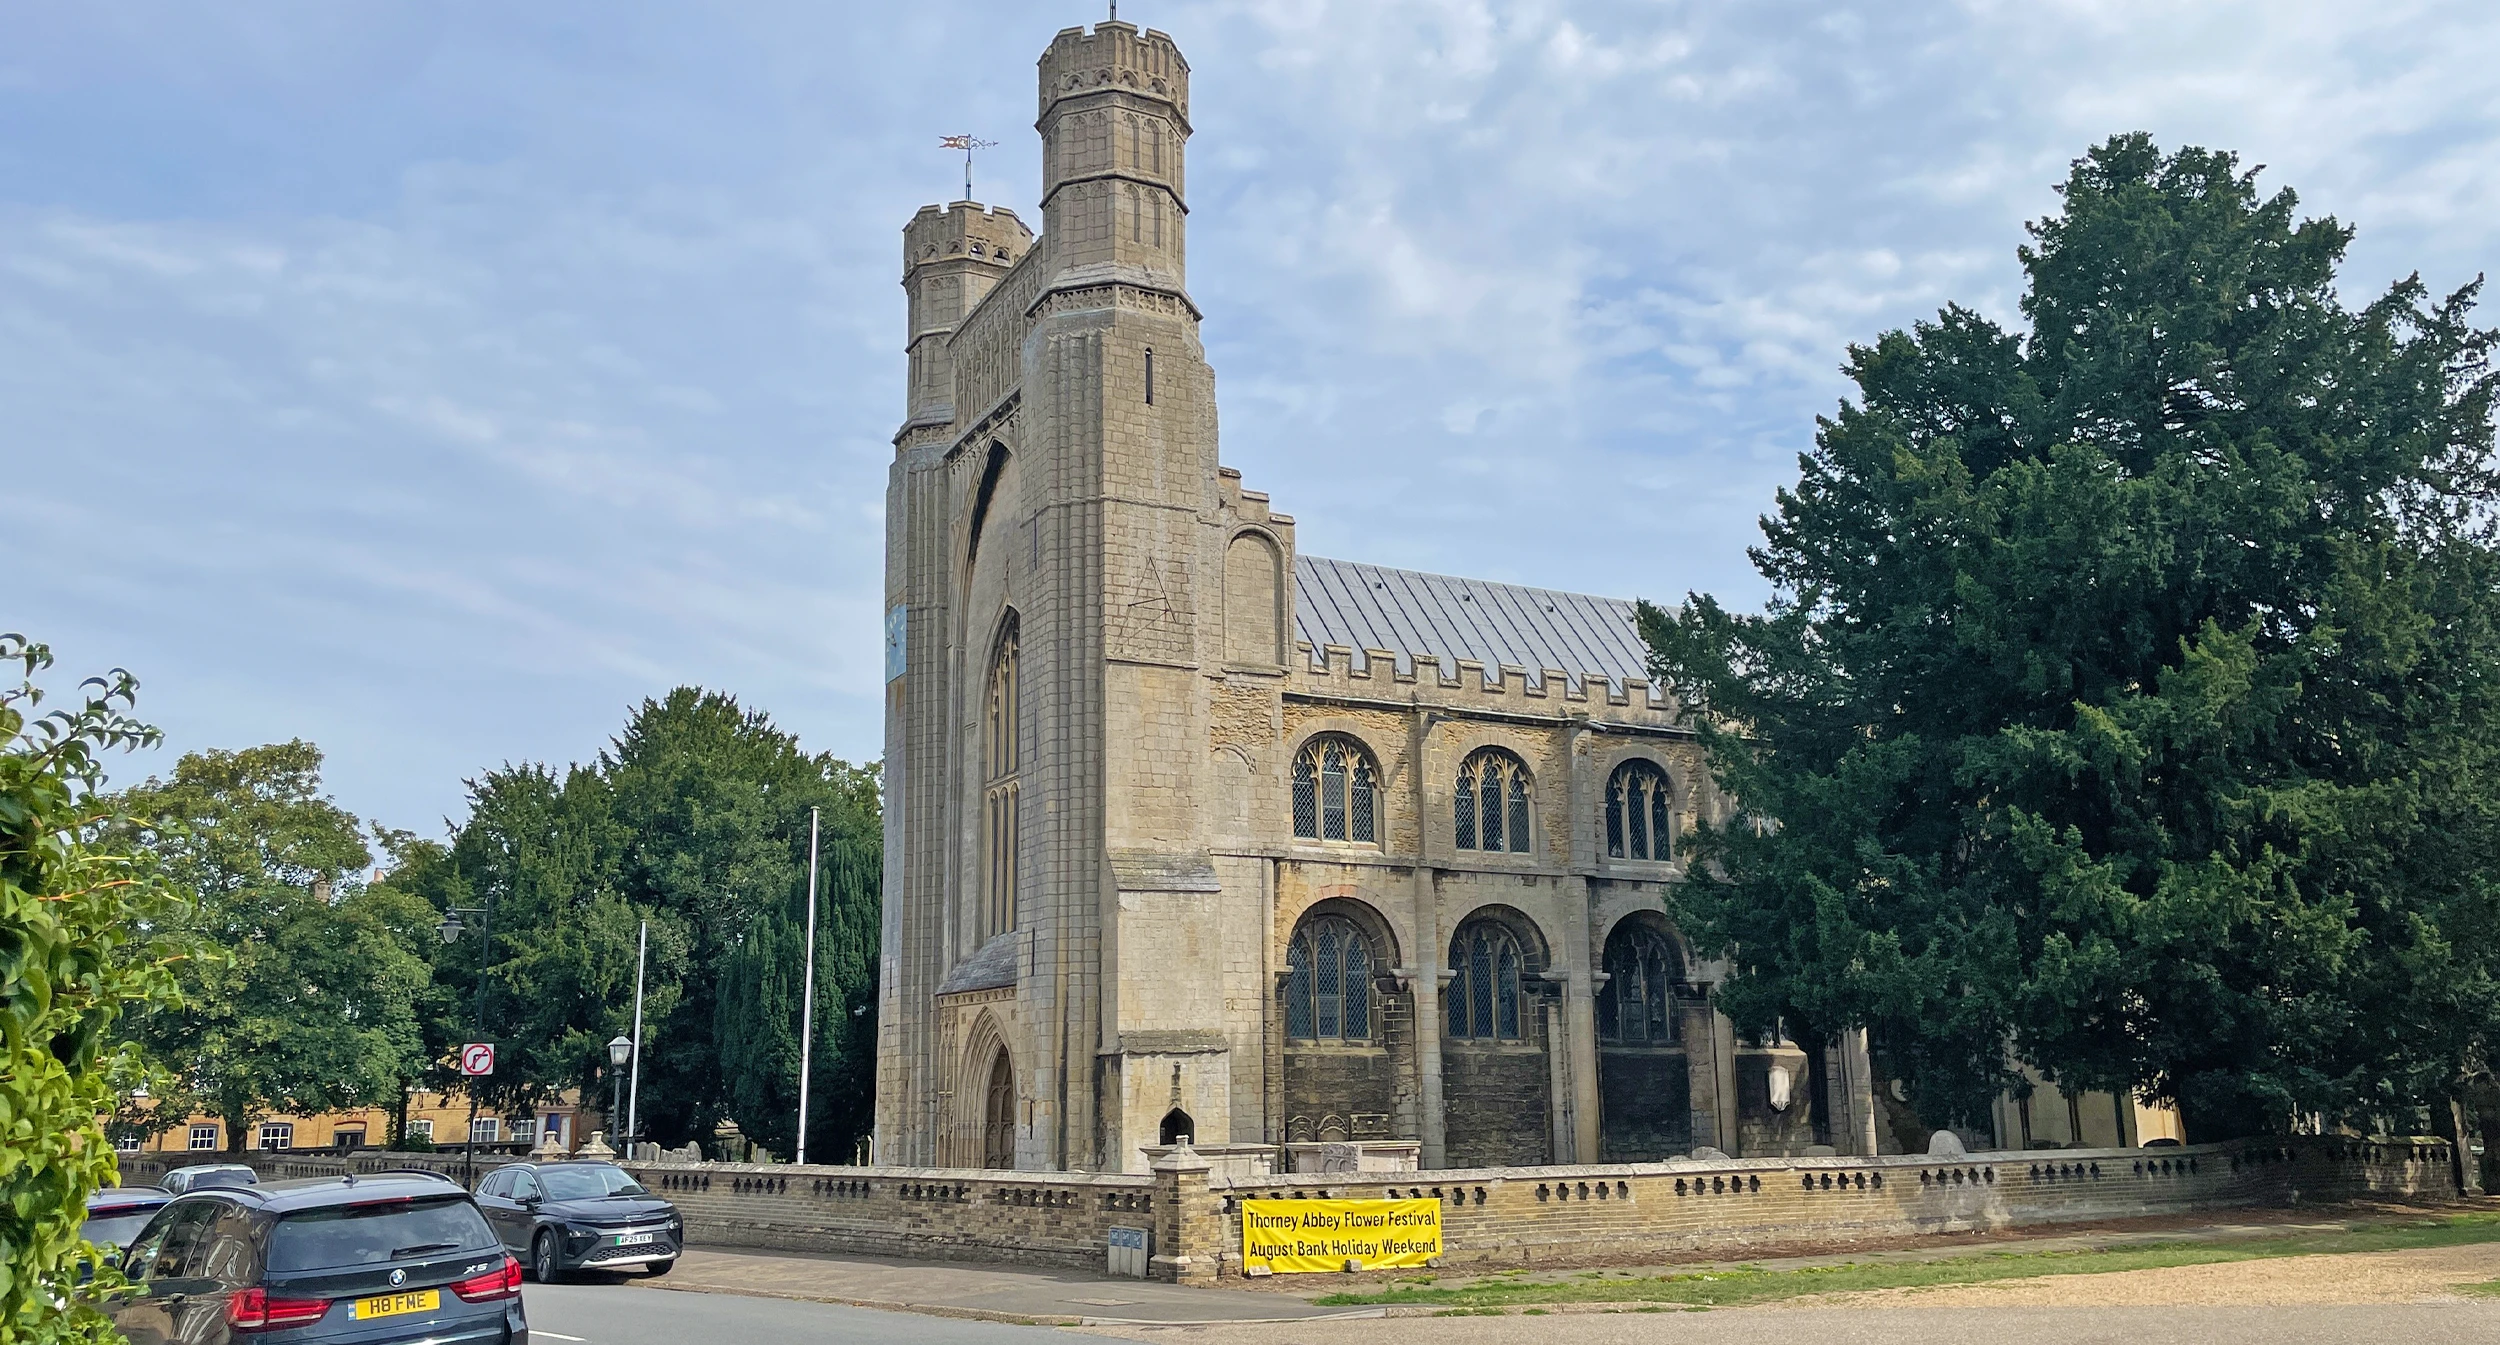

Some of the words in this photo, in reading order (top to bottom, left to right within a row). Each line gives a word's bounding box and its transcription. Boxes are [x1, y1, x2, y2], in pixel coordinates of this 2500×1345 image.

[1248, 1212, 1298, 1232] Thorney
[1302, 1212, 1341, 1231] Abbey
[1344, 1211, 1384, 1227] Flower
[1388, 1210, 1436, 1226] Festival
[1250, 1241, 1293, 1261] August
[1297, 1240, 1329, 1256] Bank
[1332, 1239, 1378, 1259] Holiday
[1382, 1238, 1436, 1254] Weekend
[463, 1263, 488, 1275] X5
[370, 1300, 391, 1314] H8
[396, 1293, 427, 1311] FME
